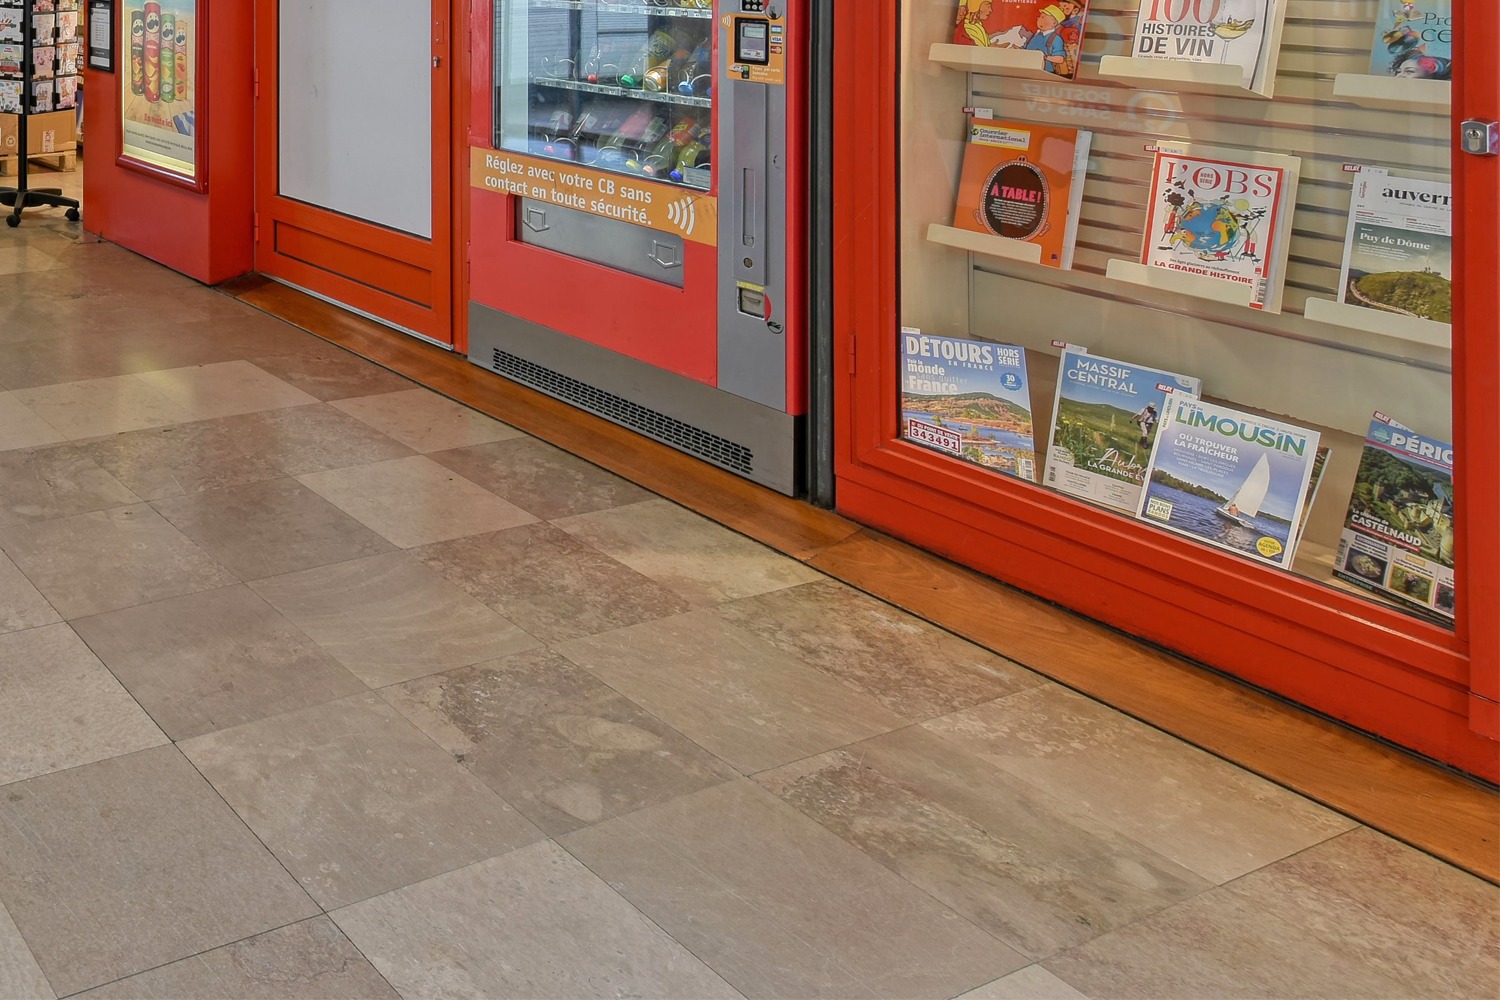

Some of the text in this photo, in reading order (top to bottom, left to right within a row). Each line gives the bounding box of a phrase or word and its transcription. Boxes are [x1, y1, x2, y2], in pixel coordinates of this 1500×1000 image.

[1141, 23, 1216, 38] HISTOIRES
[1139, 36, 1215, 57] DE VIN
[980, 128, 1008, 136] Courrier
[980, 133, 1026, 143] international
[486, 154, 652, 203] Réglez avec votre CB sans
[1165, 161, 1272, 198] L'OBS
[485, 175, 652, 225] contact en toute sécurité.
[991, 182, 999, 196] À
[1002, 186, 1036, 202] TABLE
[1360, 232, 1431, 250] Puy de Dôme
[1154, 260, 1253, 284] LA GRANDE HISTOIRE
[905, 336, 993, 364] DÉTOURS
[997, 347, 1019, 358] HORS
[907, 363, 945, 376] monde
[962, 362, 994, 371] FRANCE
[998, 356, 1020, 367] SÉRIE
[1077, 359, 1131, 380] MASSIF
[909, 375, 958, 393] France
[1067, 369, 1138, 394] CENTRAL
[912, 428, 958, 450] 343491
[1179, 433, 1237, 455] OÙ TROUVER
[1174, 439, 1187, 448] LA
[1187, 443, 1239, 463] FRAÎCHEUR
[1087, 461, 1098, 469] LA
[1099, 463, 1134, 479] GRANDE
[1149, 504, 1169, 515] PLANS
[1352, 514, 1421, 547] CASTELNAUD
